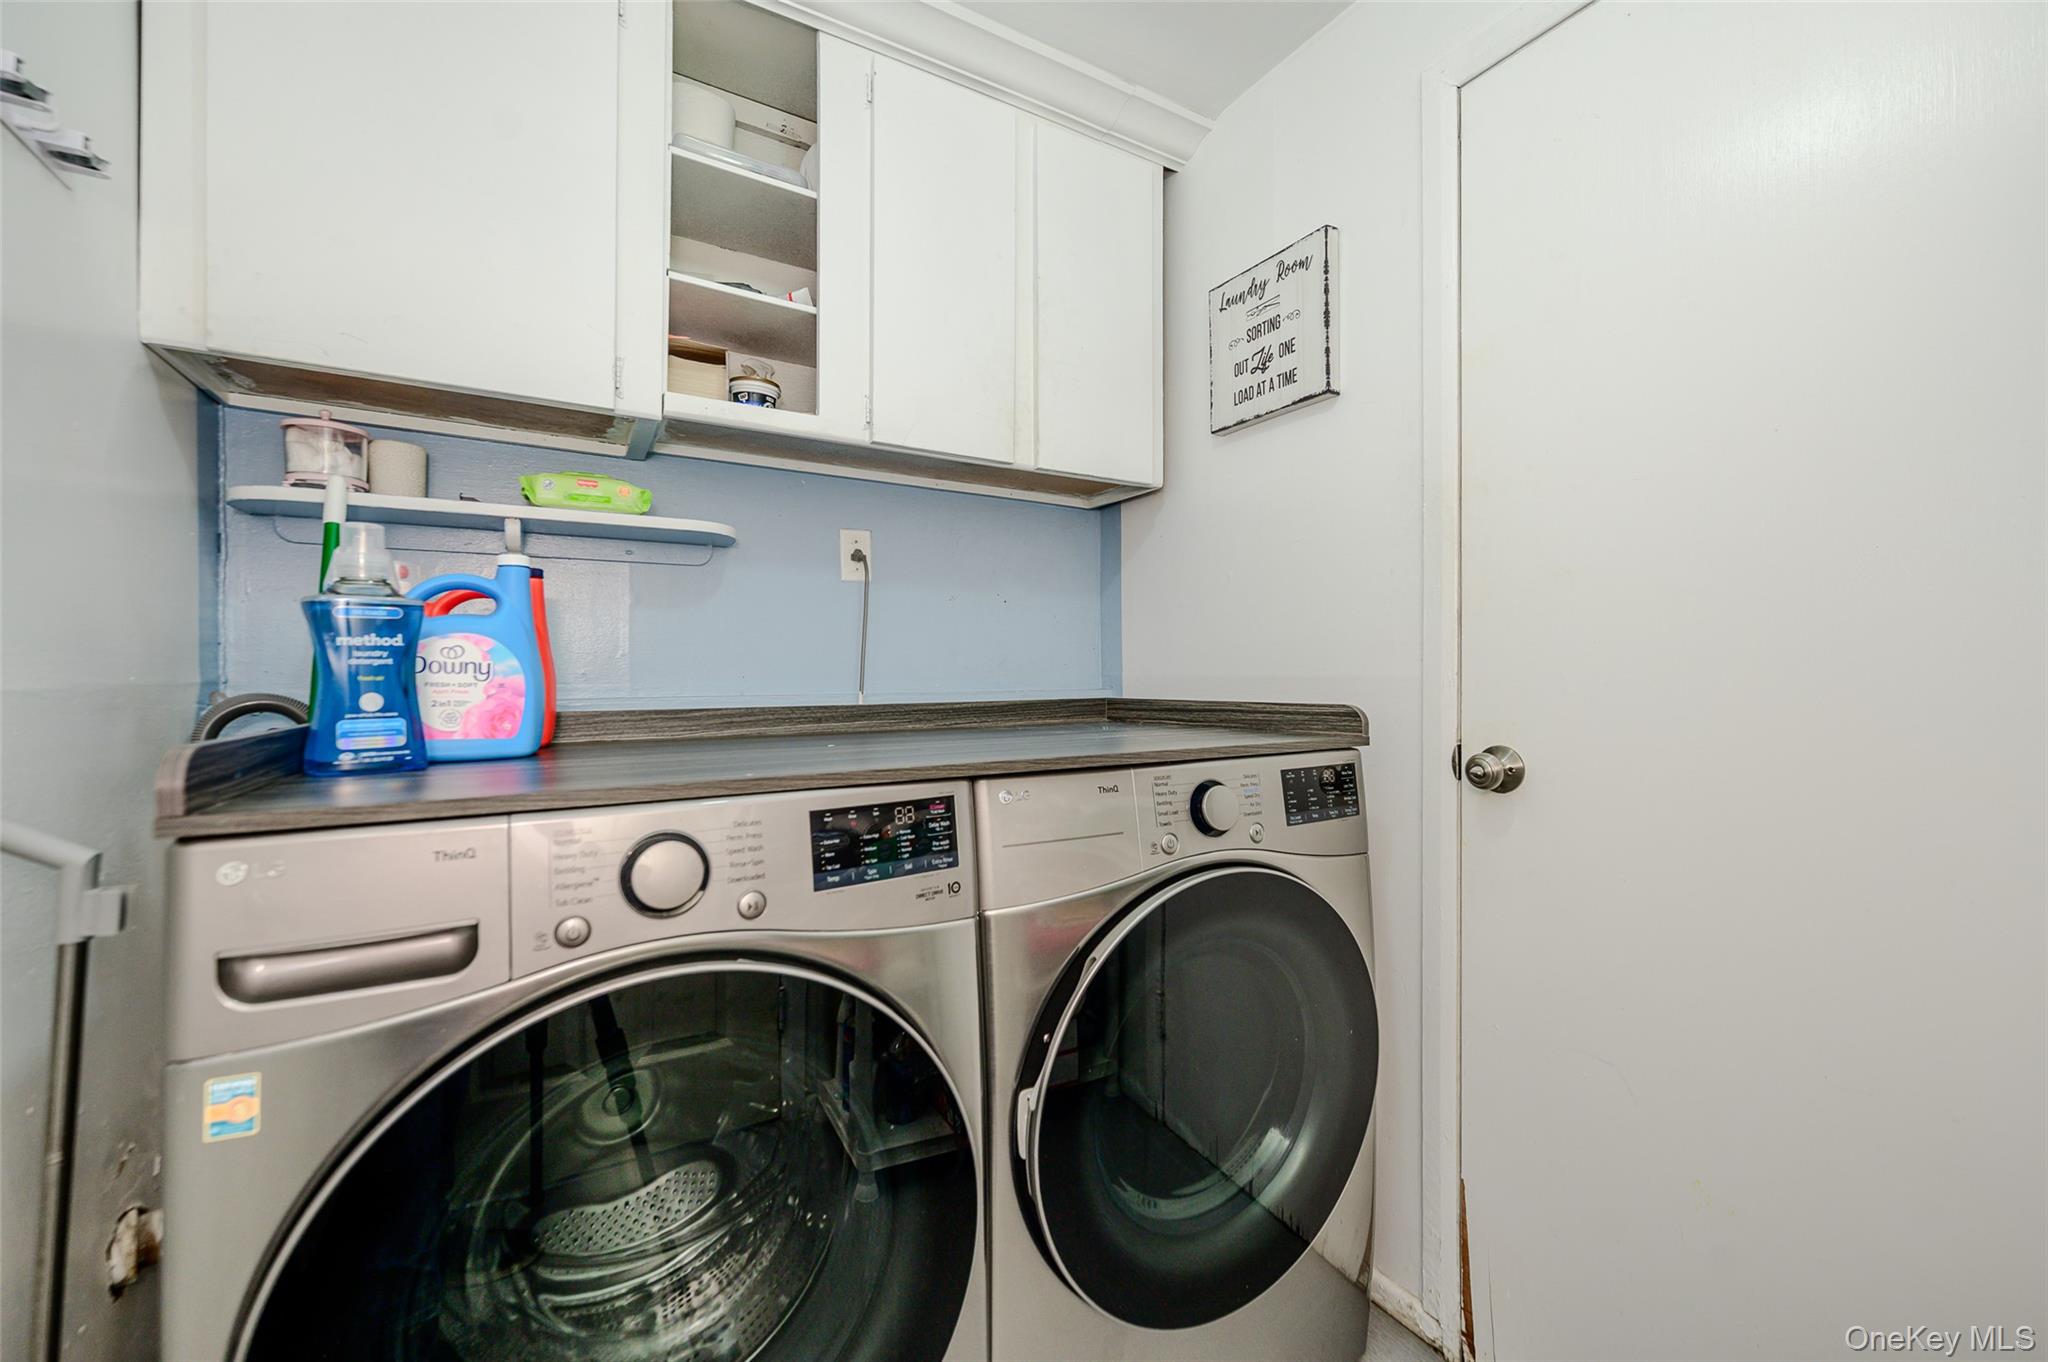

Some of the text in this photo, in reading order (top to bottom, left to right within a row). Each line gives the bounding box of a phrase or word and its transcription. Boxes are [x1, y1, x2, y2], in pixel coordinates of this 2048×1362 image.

[1219, 255, 1313, 312] Laundry Room
[1246, 314, 1280, 343] SORTING
[1234, 337, 1296, 377] OUT Life ONE
[1233, 367, 1298, 406] LOAD AT A TIME
[415, 655, 491, 682] Downy
[1097, 784, 1119, 794] ThinQ
[432, 847, 477, 863] ThinQ
[947, 881, 961, 895] 10
